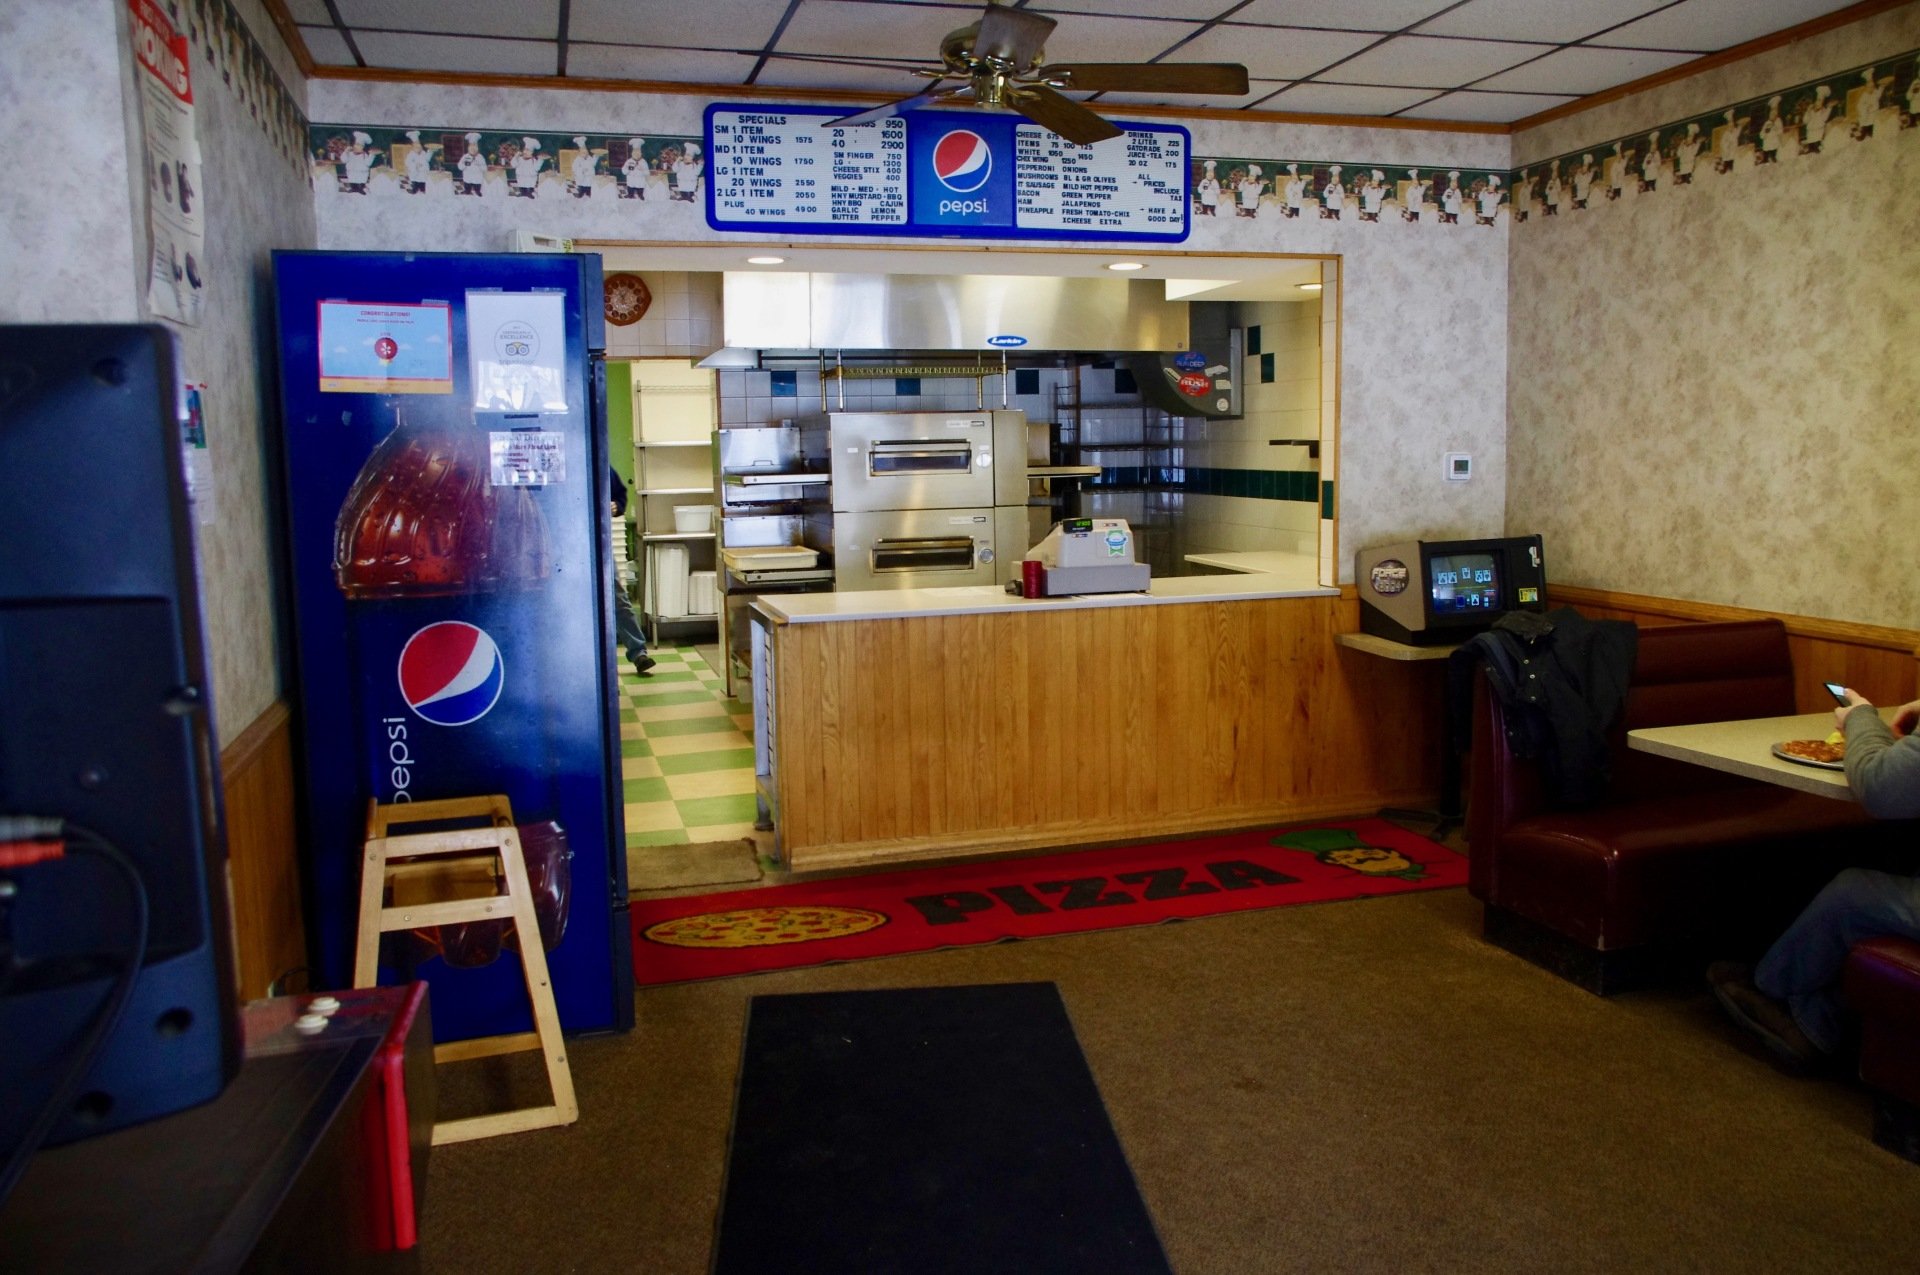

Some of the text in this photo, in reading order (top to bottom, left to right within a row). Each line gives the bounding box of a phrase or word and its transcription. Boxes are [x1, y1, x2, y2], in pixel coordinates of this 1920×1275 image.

[738, 115, 786, 125] SPECIALS
[886, 120, 903, 128] 950
[715, 125, 763, 134] SM 1 ITEM
[833, 129, 844, 137] 20
[734, 135, 743, 143] 10
[750, 136, 781, 144] WINGS
[832, 140, 904, 149] 40 2900
[715, 145, 729, 153] MD
[741, 146, 764, 154] ITEM
[733, 157, 742, 165] 10
[750, 157, 782, 165] WINGS
[716, 167, 728, 175] LG
[741, 168, 763, 176] ITEM
[732, 178, 744, 186] 20
[750, 179, 782, 187] WINGS
[750, 189, 774, 197] ITEM
[940, 198, 988, 216] pepsi
[905, 860, 1300, 926] PIZZA
